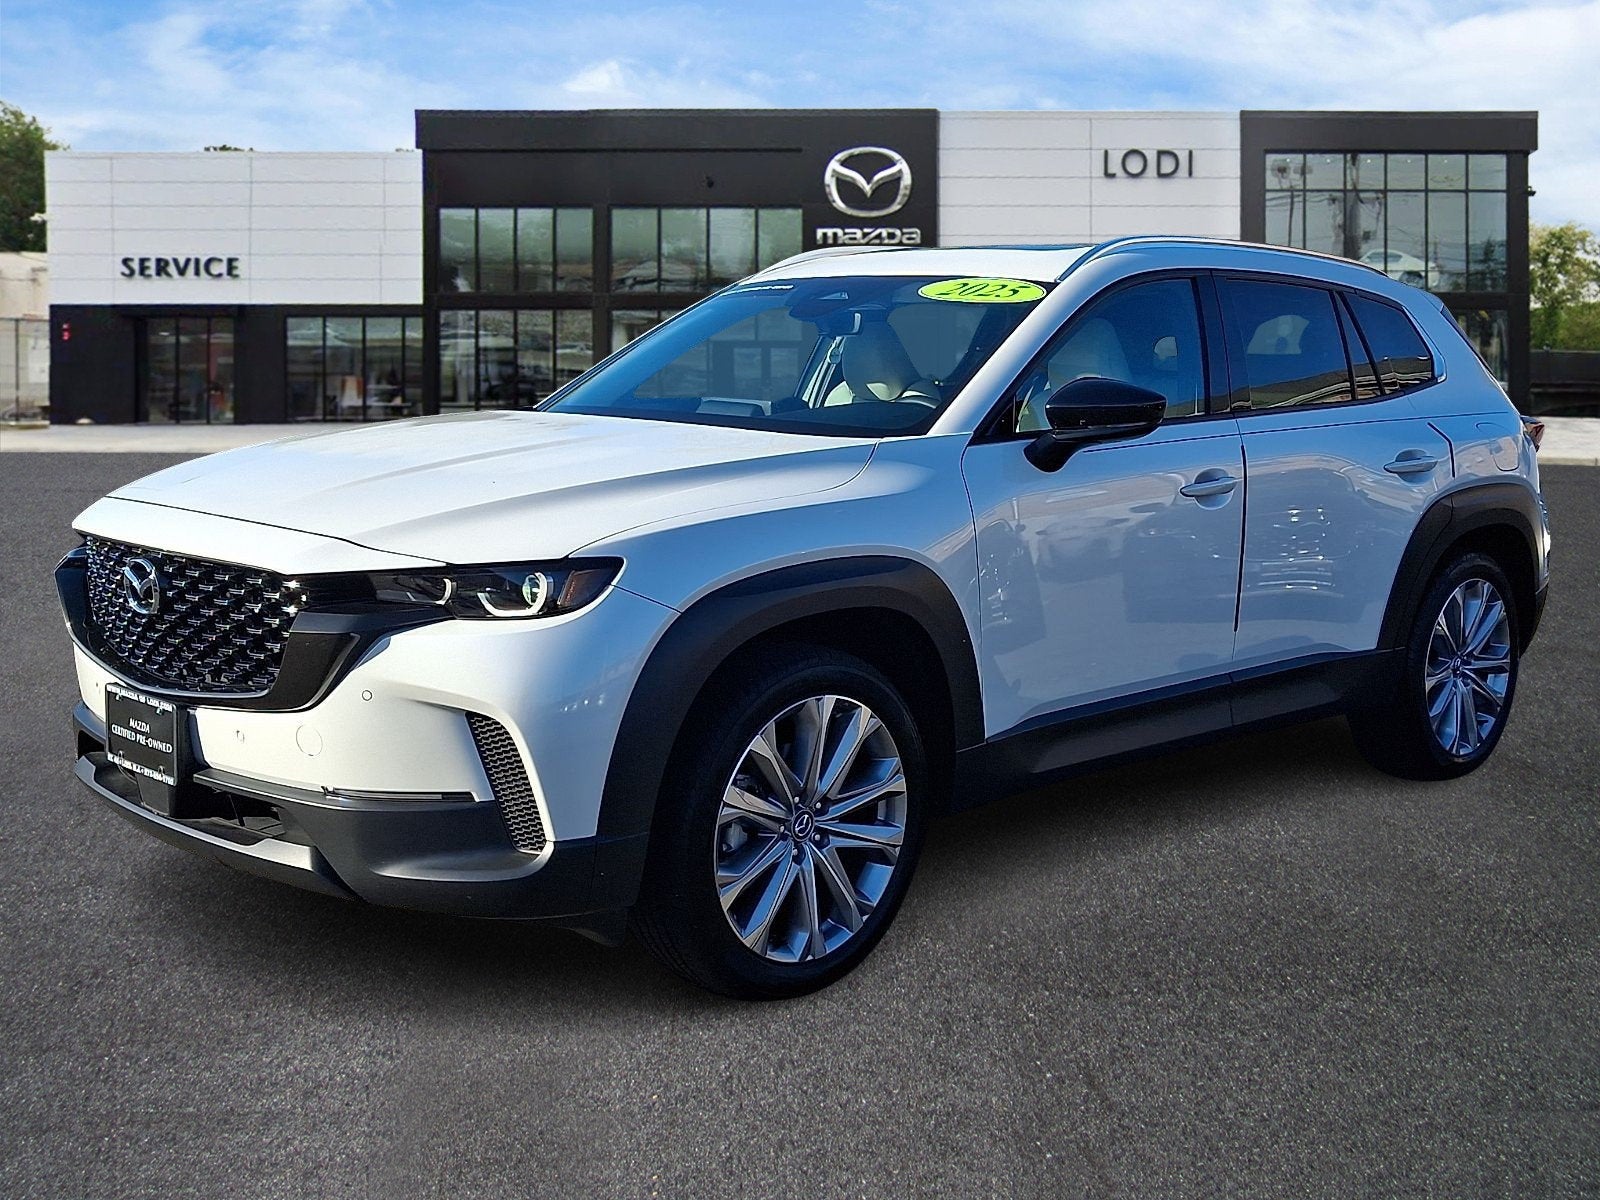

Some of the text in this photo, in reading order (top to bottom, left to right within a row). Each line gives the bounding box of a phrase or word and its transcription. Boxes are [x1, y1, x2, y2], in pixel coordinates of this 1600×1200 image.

[1104, 149, 1193, 178] LODI
[120, 256, 240, 279] SERVICE
[936, 282, 1031, 298] 2025
[129, 718, 150, 733] MAZDA
[111, 724, 173, 753] CERTIFIED PRE-OWNED
